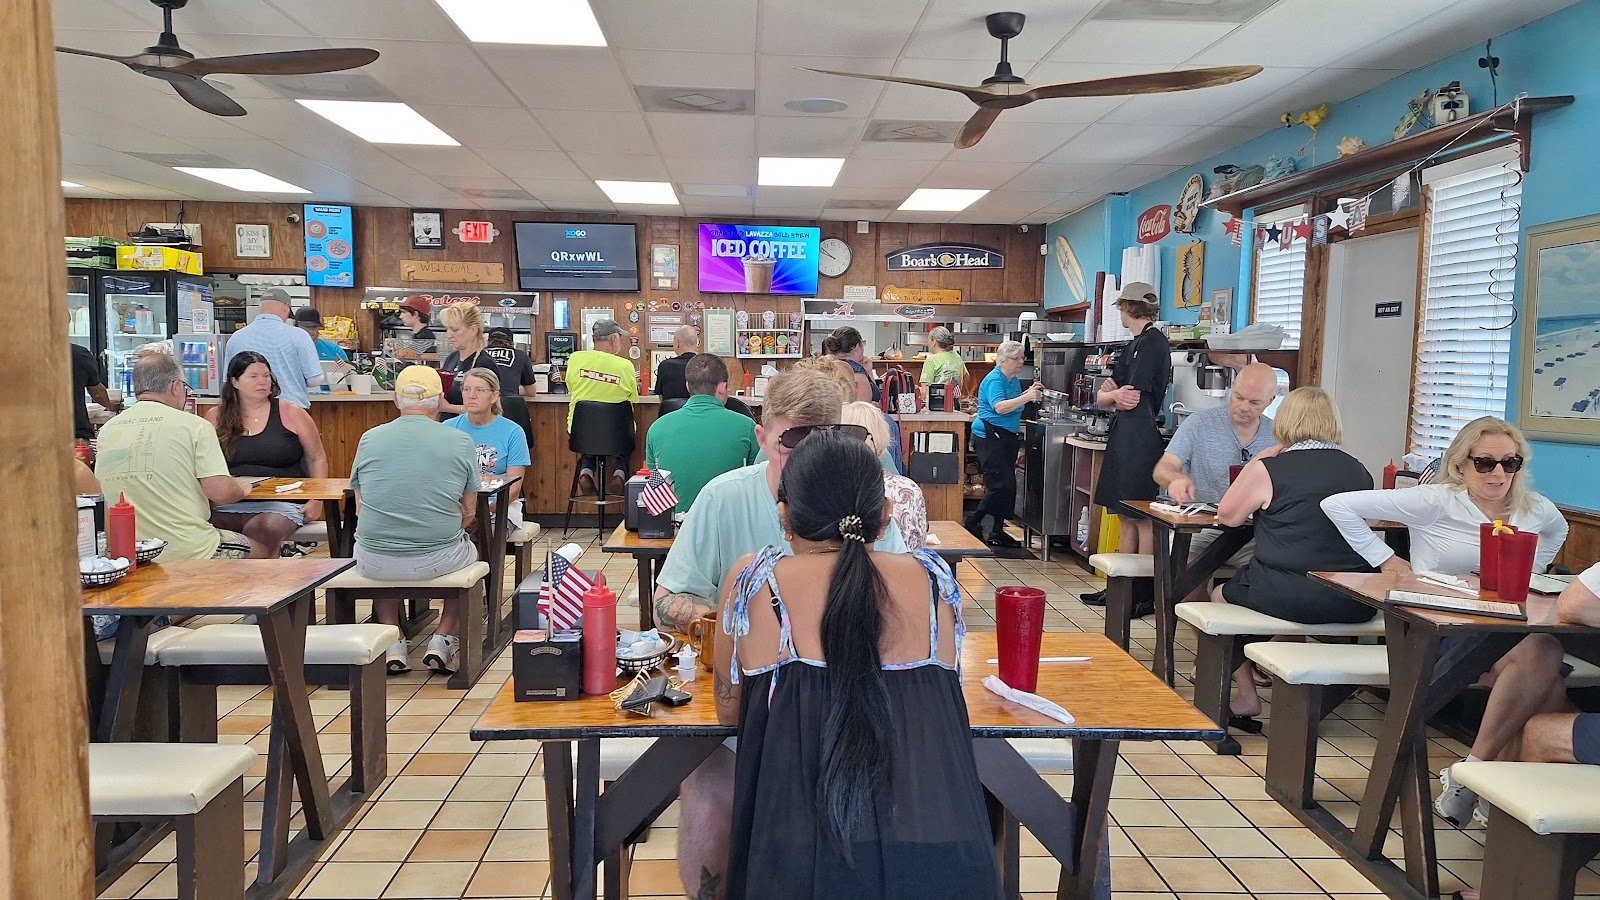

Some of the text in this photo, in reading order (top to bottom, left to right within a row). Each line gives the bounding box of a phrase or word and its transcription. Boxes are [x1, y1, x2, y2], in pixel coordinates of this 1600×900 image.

[465, 223, 489, 240] EXIT
[565, 229, 586, 237] XOGO
[745, 230, 773, 238] LAVAZZA
[1281, 226, 1291, 243] U
[711, 239, 807, 259] ICED COFFEE
[551, 251, 604, 262] QRxwWL
[901, 252, 989, 267] Boar's Head
[420, 262, 473, 275] WELCOME
